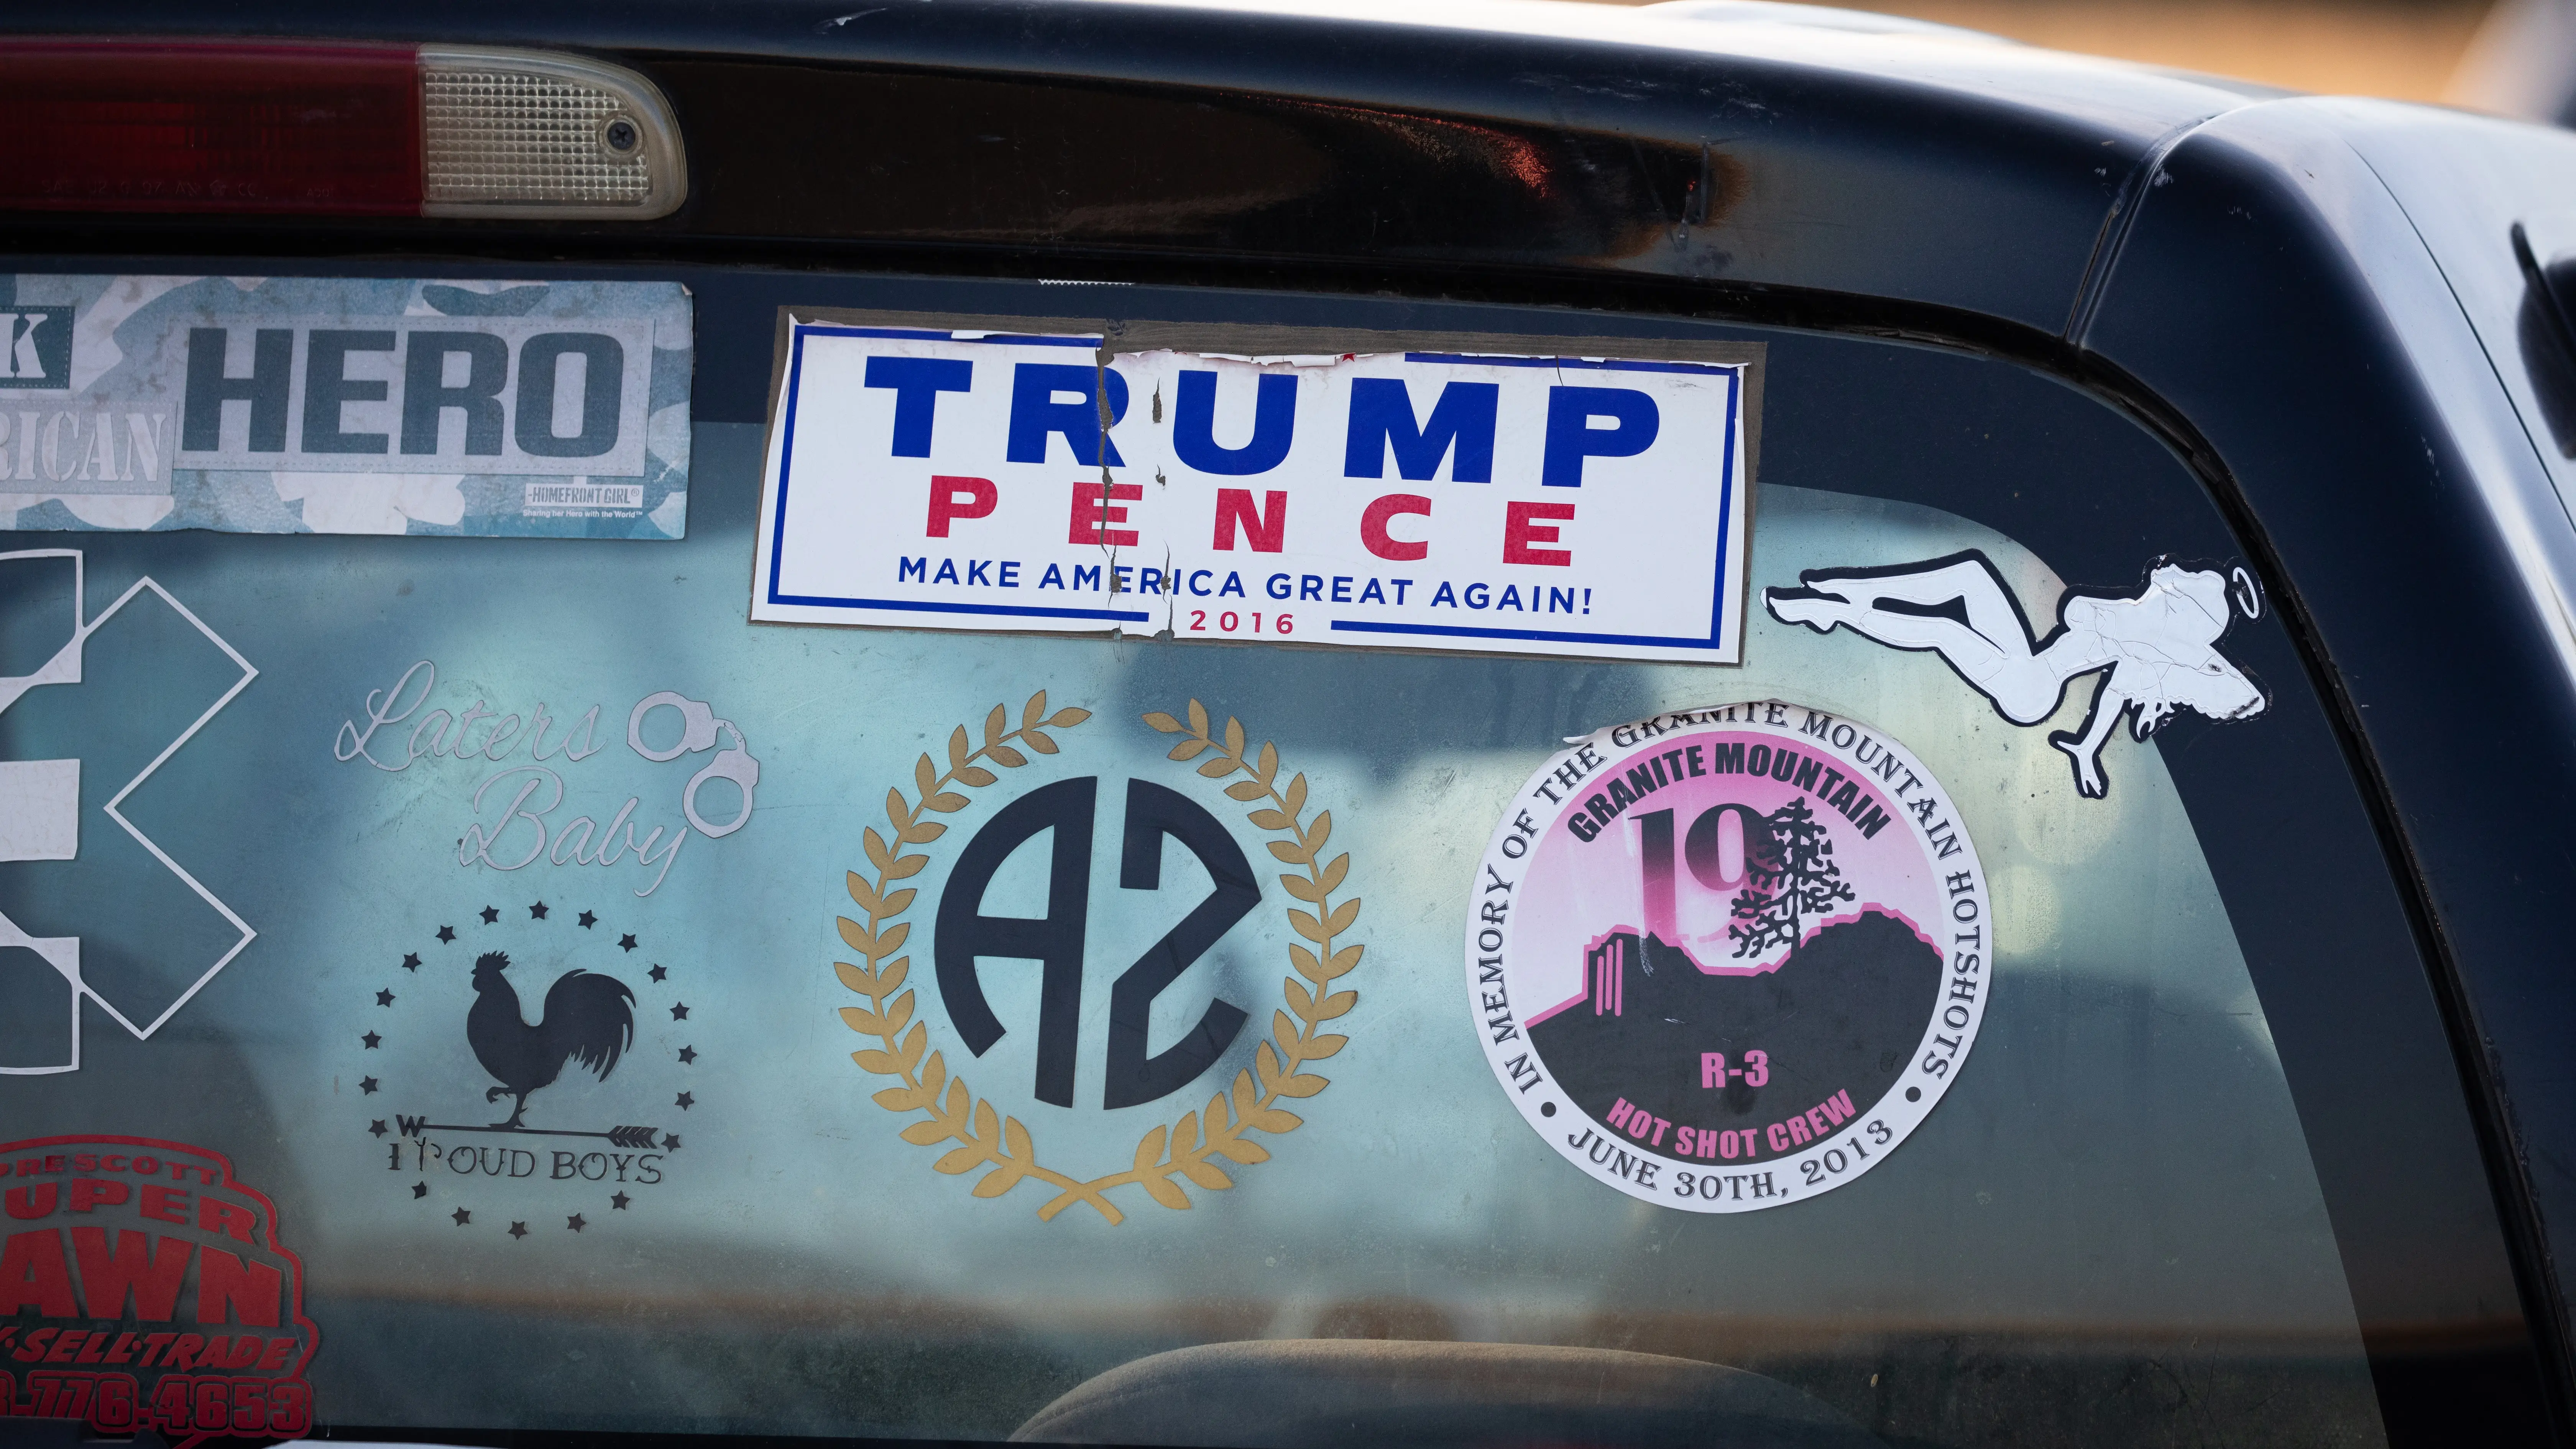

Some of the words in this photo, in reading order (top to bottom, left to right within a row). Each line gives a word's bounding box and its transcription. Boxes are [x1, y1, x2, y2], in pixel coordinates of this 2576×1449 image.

[182, 327, 624, 457] HERO
[864, 356, 1660, 487] TRUMP
[523, 509, 550, 518] Sharing
[926, 475, 1575, 567] PENCE
[898, 556, 1020, 588] MAKE
[1038, 563, 1245, 598] AMERICA
[1266, 573, 1413, 606] GREAT
[1430, 580, 1592, 614] AGAIN!
[1190, 610, 1293, 634] 2016
[334, 660, 608, 772] Laters
[1533, 743, 1607, 805] THE
[1567, 744, 1706, 843] GRANITE
[1714, 743, 1892, 841] MOUNTAIN
[1798, 710, 1963, 859] MOUNTAIN
[459, 765, 688, 897] Baby
[1502, 809, 1542, 859] OF
[1478, 864, 1521, 1046] MEMORY
[1922, 869, 1982, 1079] HOTSHOTS
[1505, 1053, 1543, 1094] IN
[1701, 1050, 1769, 1089] R-3
[1568, 1127, 1662, 1190] JUNE
[1674, 1172, 1788, 1201] 30TH,
[1799, 1119, 1893, 1186] 2013
[1606, 1097, 1672, 1146] HOT
[1674, 1126, 1755, 1159] SHOT
[1766, 1089, 1856, 1152] CREW
[550, 1151, 664, 1184] BOYS
[5, 1178, 256, 1245] UPER
[0, 1227, 282, 1327] AWN
